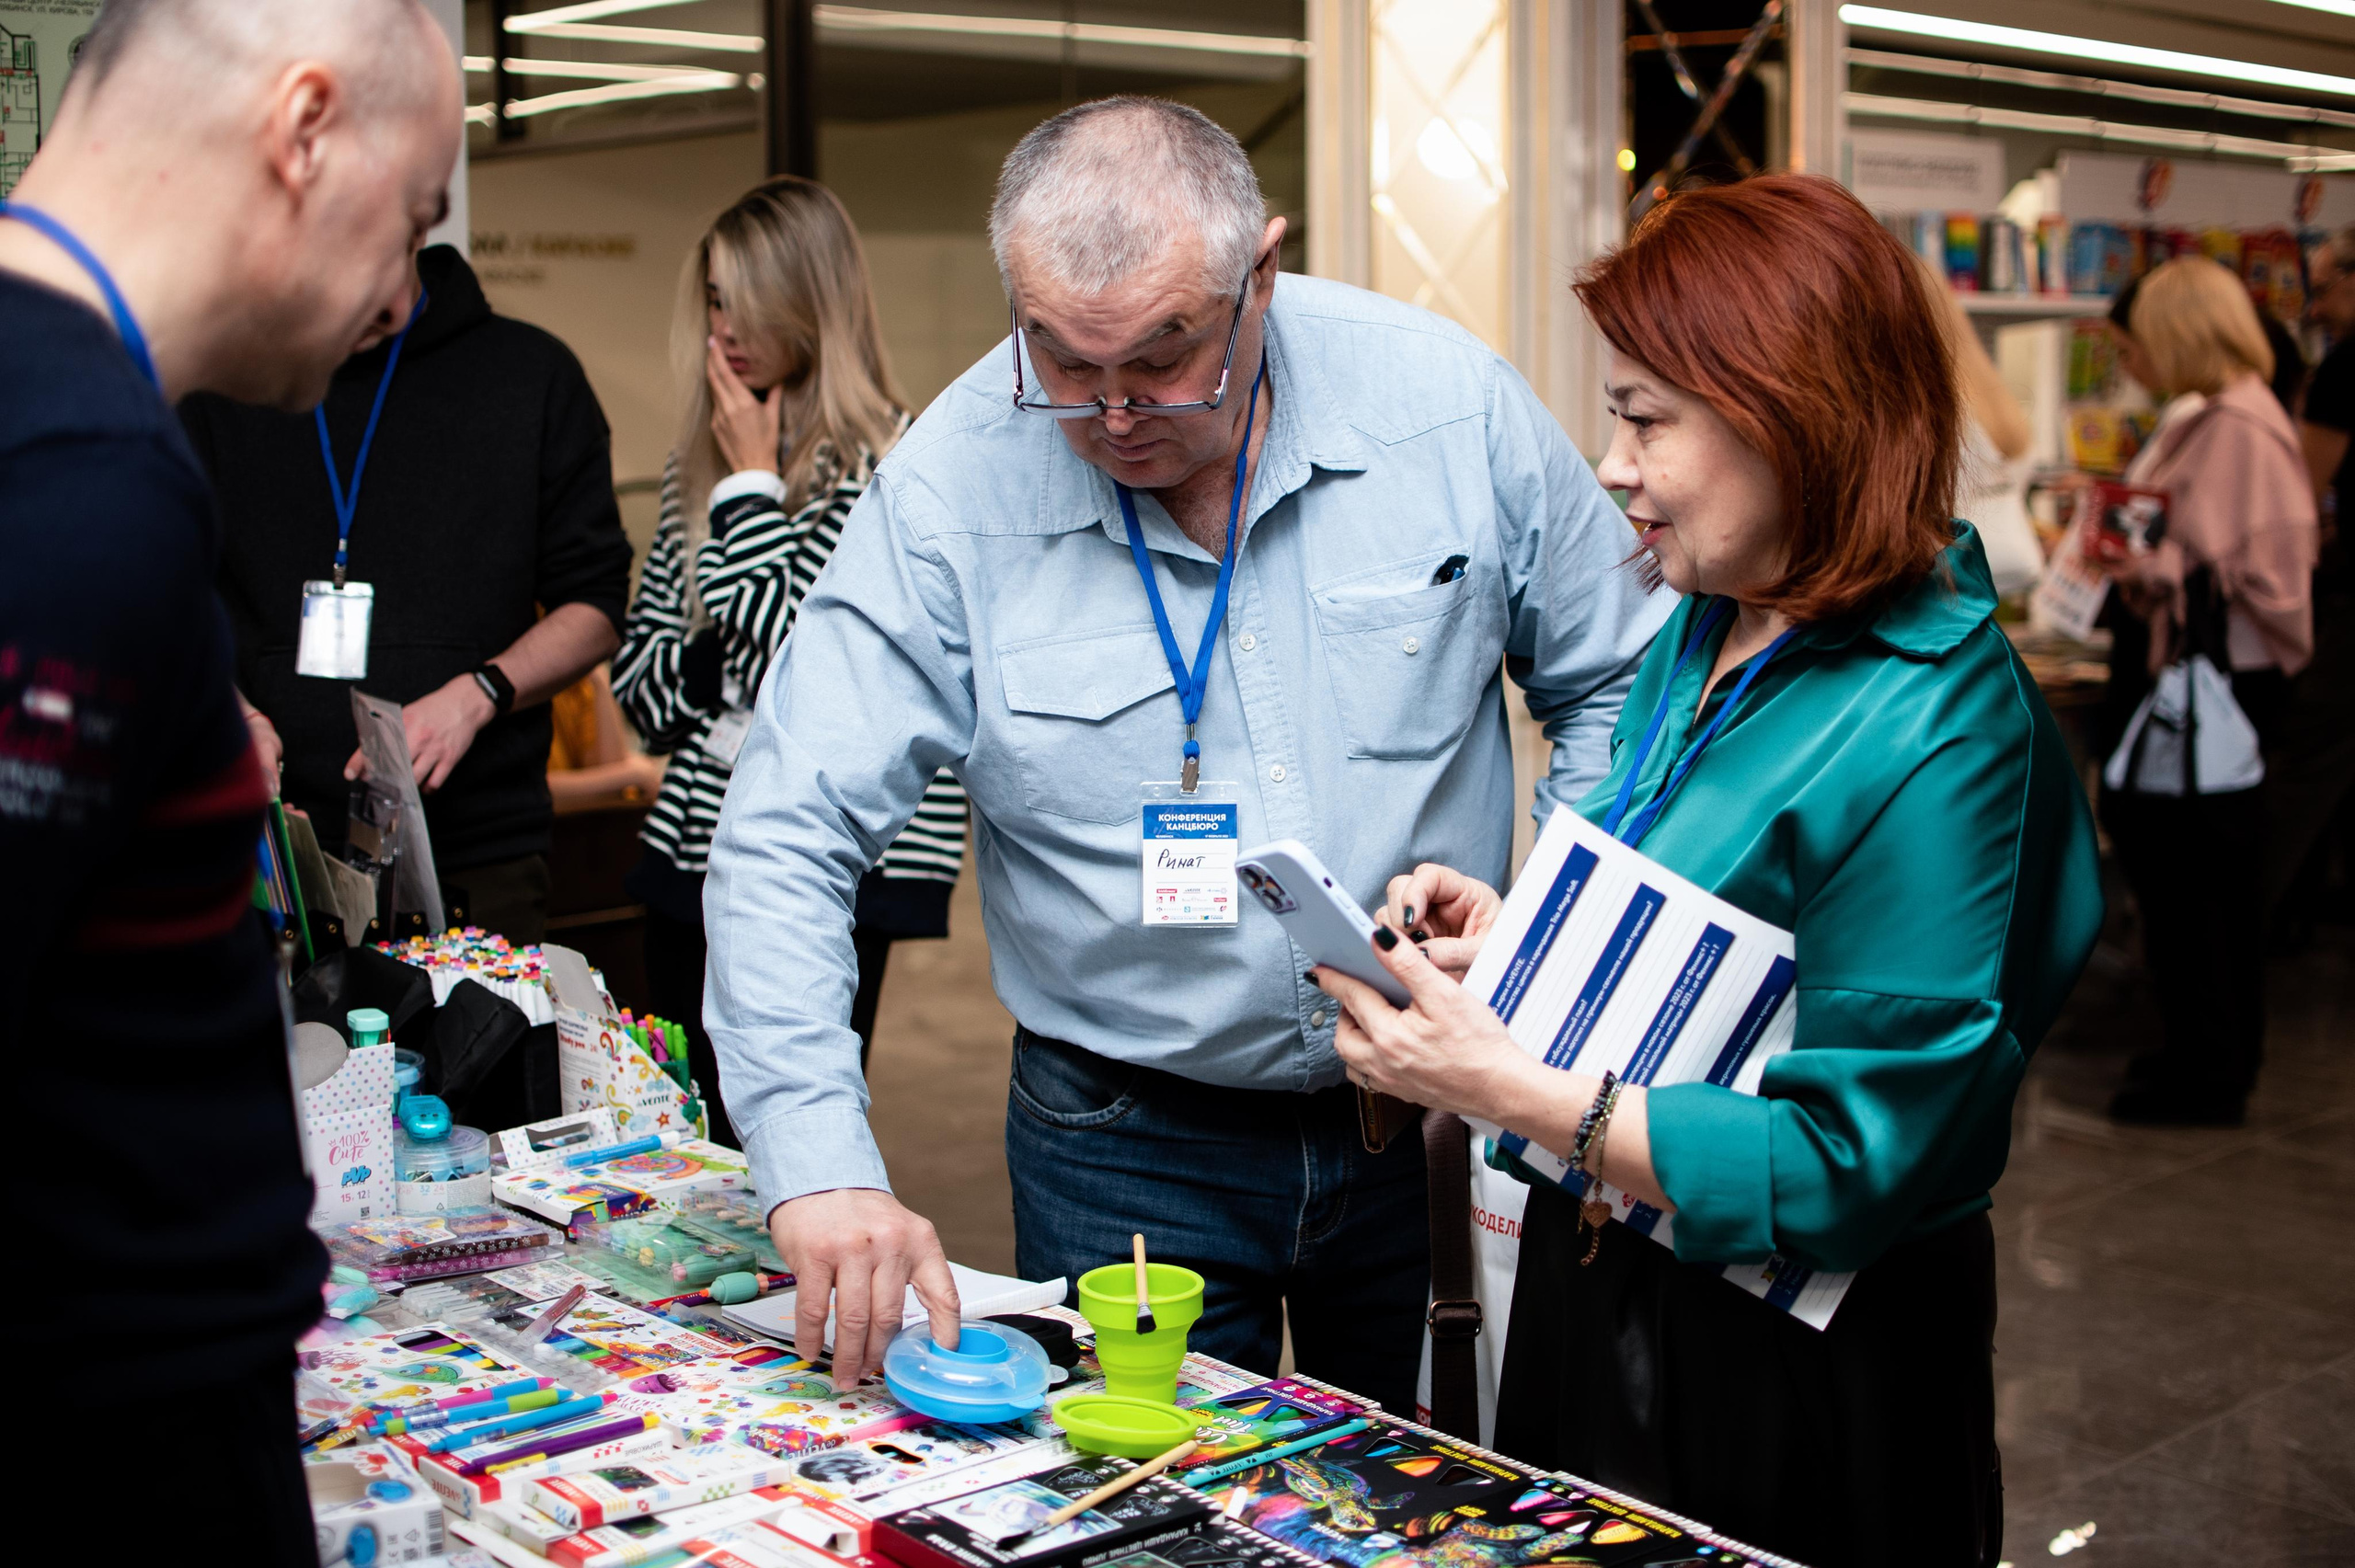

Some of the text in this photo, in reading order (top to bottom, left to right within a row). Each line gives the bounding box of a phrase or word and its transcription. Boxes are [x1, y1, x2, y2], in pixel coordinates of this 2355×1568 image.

[1158, 813, 1226, 822] КОНФЕРЕНЦИЯ
[1166, 822, 1219, 831] КАНЦБЮРО
[1157, 849, 1206, 869] Ринат
[1517, 964, 1534, 988] цветов
[1531, 922, 1557, 962] карандашах
[1550, 910, 1562, 924] Trio
[1557, 892, 1573, 913] Mega
[1559, 1049, 1571, 1064] наш
[1567, 1024, 1586, 1052] логотип
[1616, 936, 1634, 960] нашей
[1627, 899, 1656, 940] продукции?
[1549, 1015, 1580, 1060] обсуждаемый
[1573, 998, 1589, 1018] пазл?
[1645, 1034, 1669, 1069] школьной
[1663, 1006, 1685, 1037] матрицы
[1679, 990, 1694, 1009] 2023
[1694, 953, 1716, 981] Феникс
[1646, 1025, 1662, 1048] новом
[1658, 1003, 1675, 1028] сезоне
[1669, 987, 1684, 1005] 2023
[1717, 1050, 1743, 1086] акриловых
[1740, 1015, 1763, 1047] гуашевых
[1759, 991, 1778, 1018] красок.
[1260, 1385, 1336, 1416] КАРАНДАШИ ЦВЕТНЫЕ
[625, 1441, 662, 1457] ШАРИКОВЫЕ
[788, 1438, 835, 1460] deVENTE
[1429, 1443, 1520, 1481] КАРАНДАШИ ЦВЕТНЫЕ
[1585, 1497, 1682, 1539] КАРАНДАШИ ЦВЕТНЫЕ
[1082, 1528, 1189, 1566] КАРАНДАШИ ЦВЕТНЫЕ JUMBO
